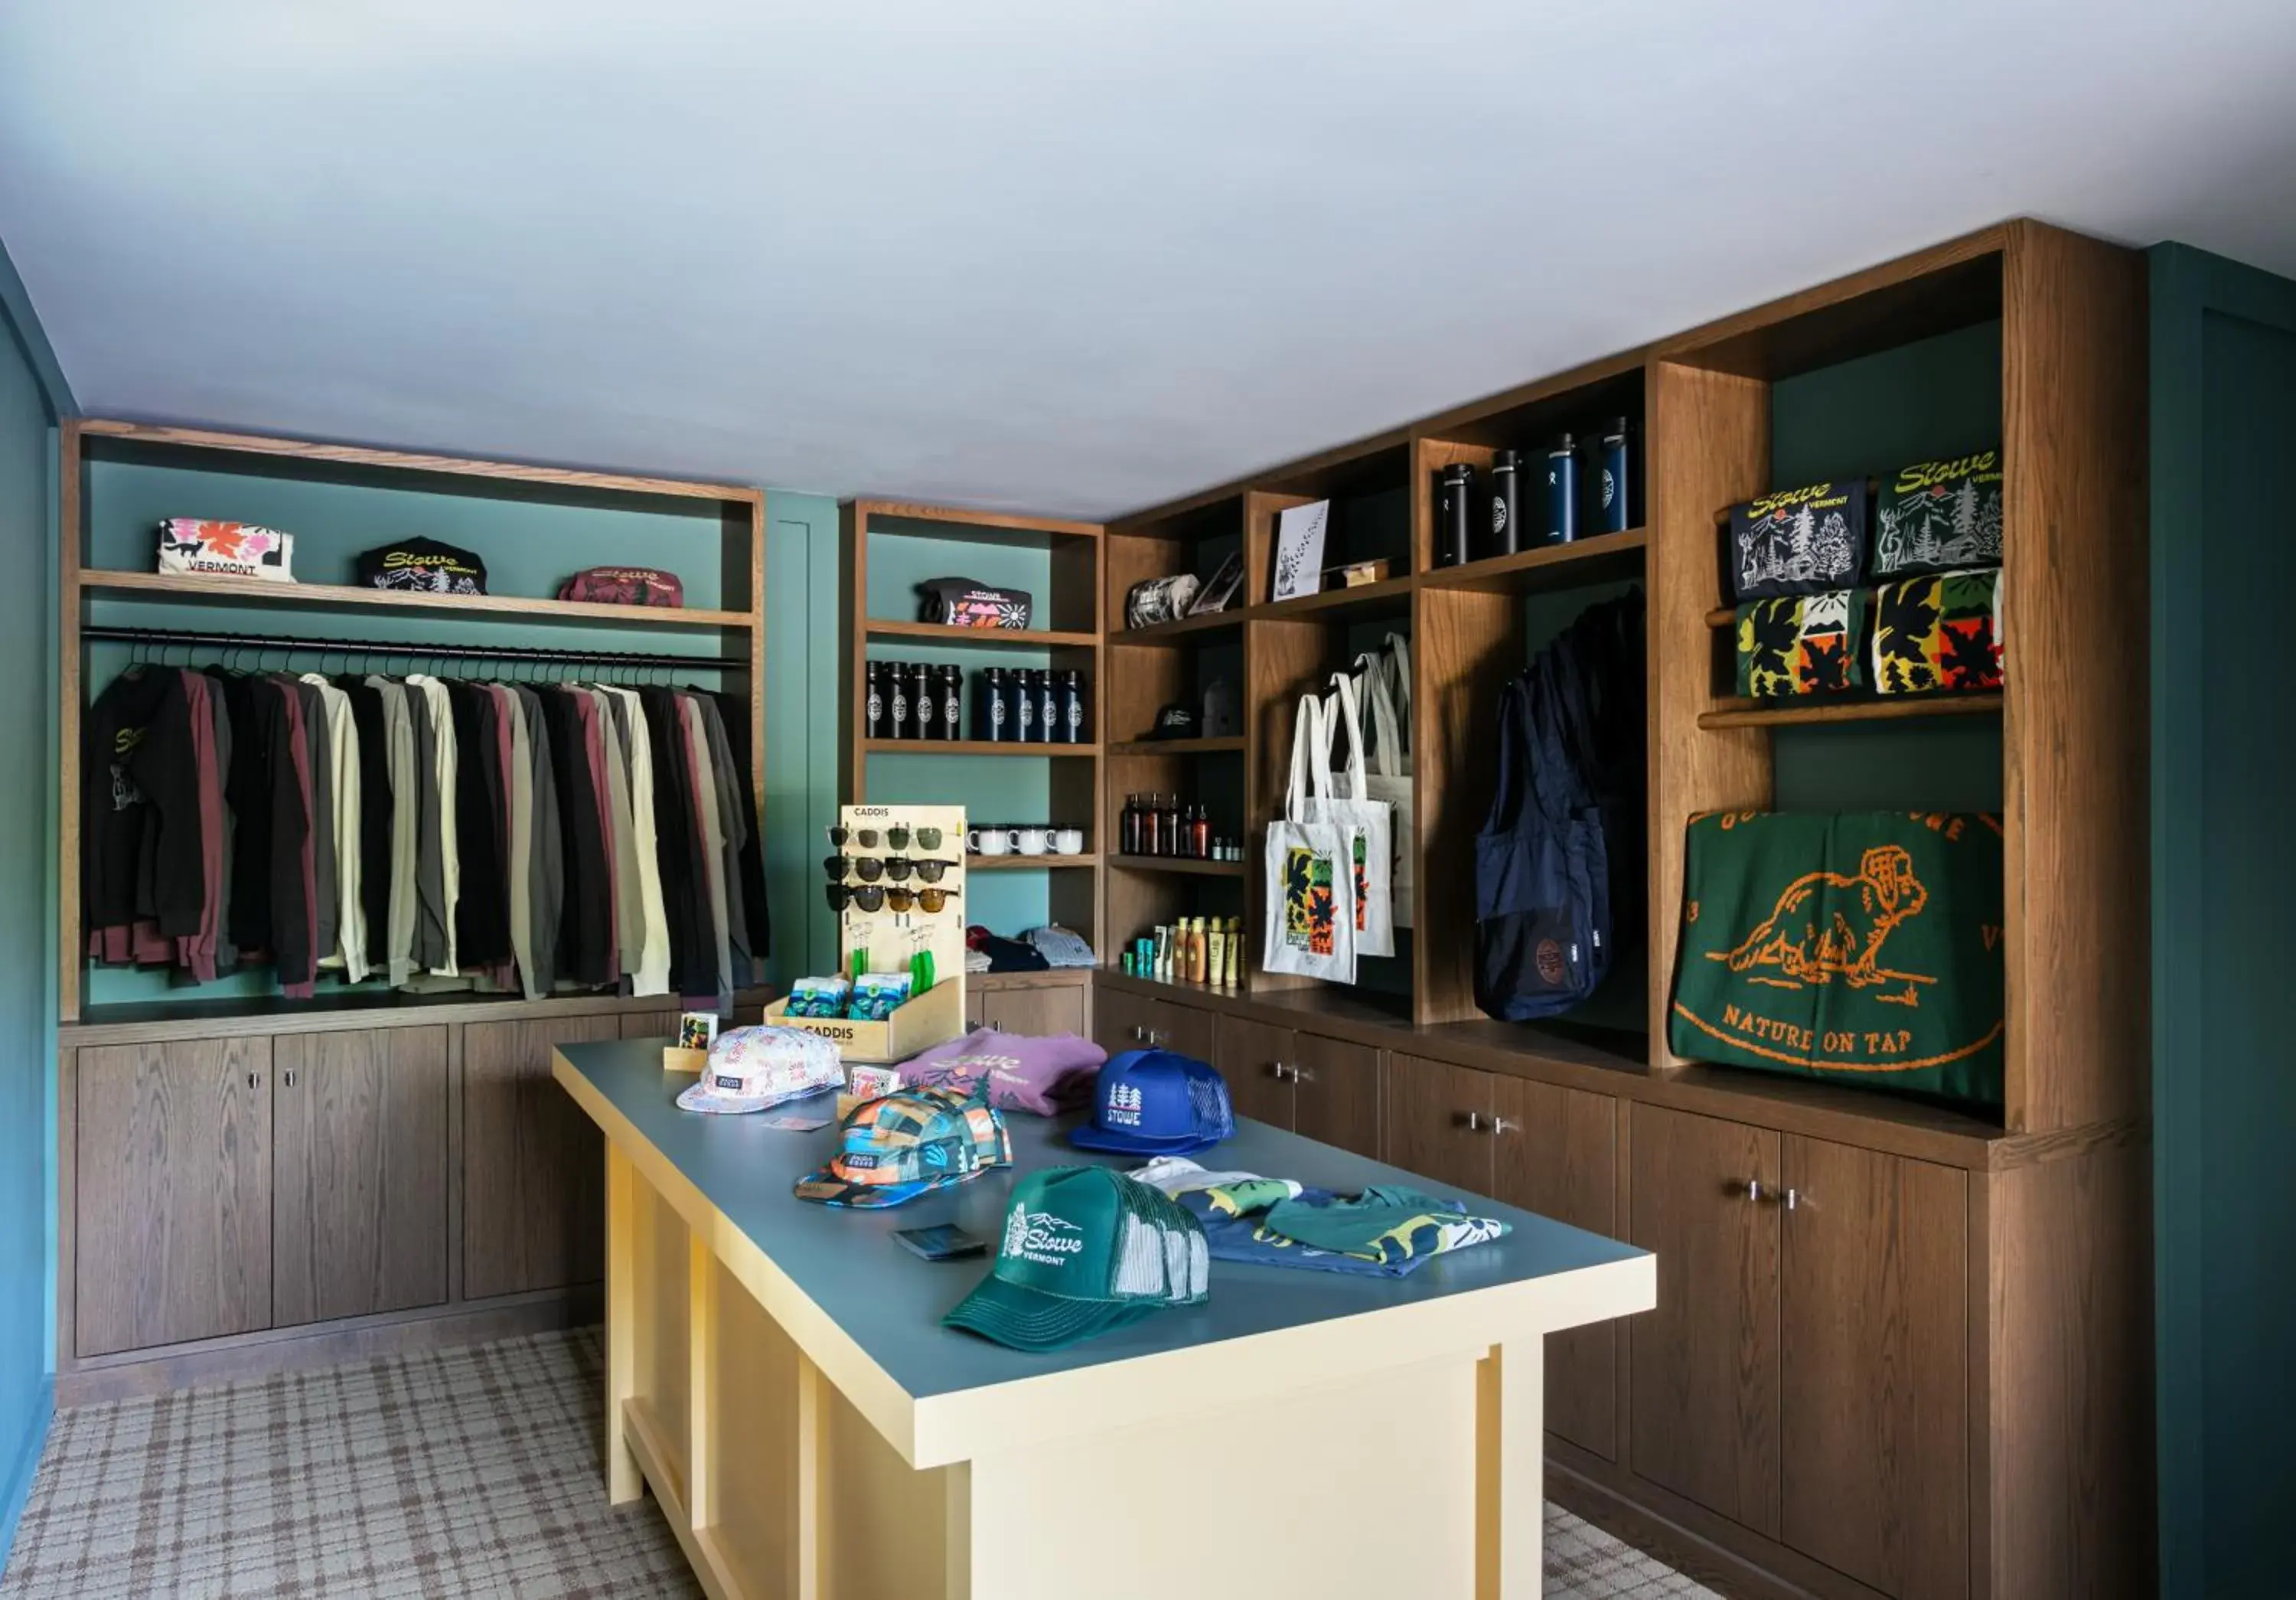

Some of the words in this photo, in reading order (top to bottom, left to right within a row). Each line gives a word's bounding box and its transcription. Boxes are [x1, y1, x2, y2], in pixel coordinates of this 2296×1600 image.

[1895, 450, 1997, 494] Stowe
[1747, 483, 1831, 518] Stowe
[1808, 496, 1848, 509] VERMONT
[188, 560, 256, 574] VERMONT
[383, 552, 459, 567] Stowe
[853, 808, 889, 817] CADDIS
[1723, 1004, 1814, 1052] NATURE
[1823, 1030, 1855, 1053] ON
[1864, 1029, 1912, 1055] TAP
[1107, 1109, 1141, 1126] STOWE
[1025, 1228, 1084, 1253] Stowe
[1022, 1251, 1066, 1267] VERMONT
